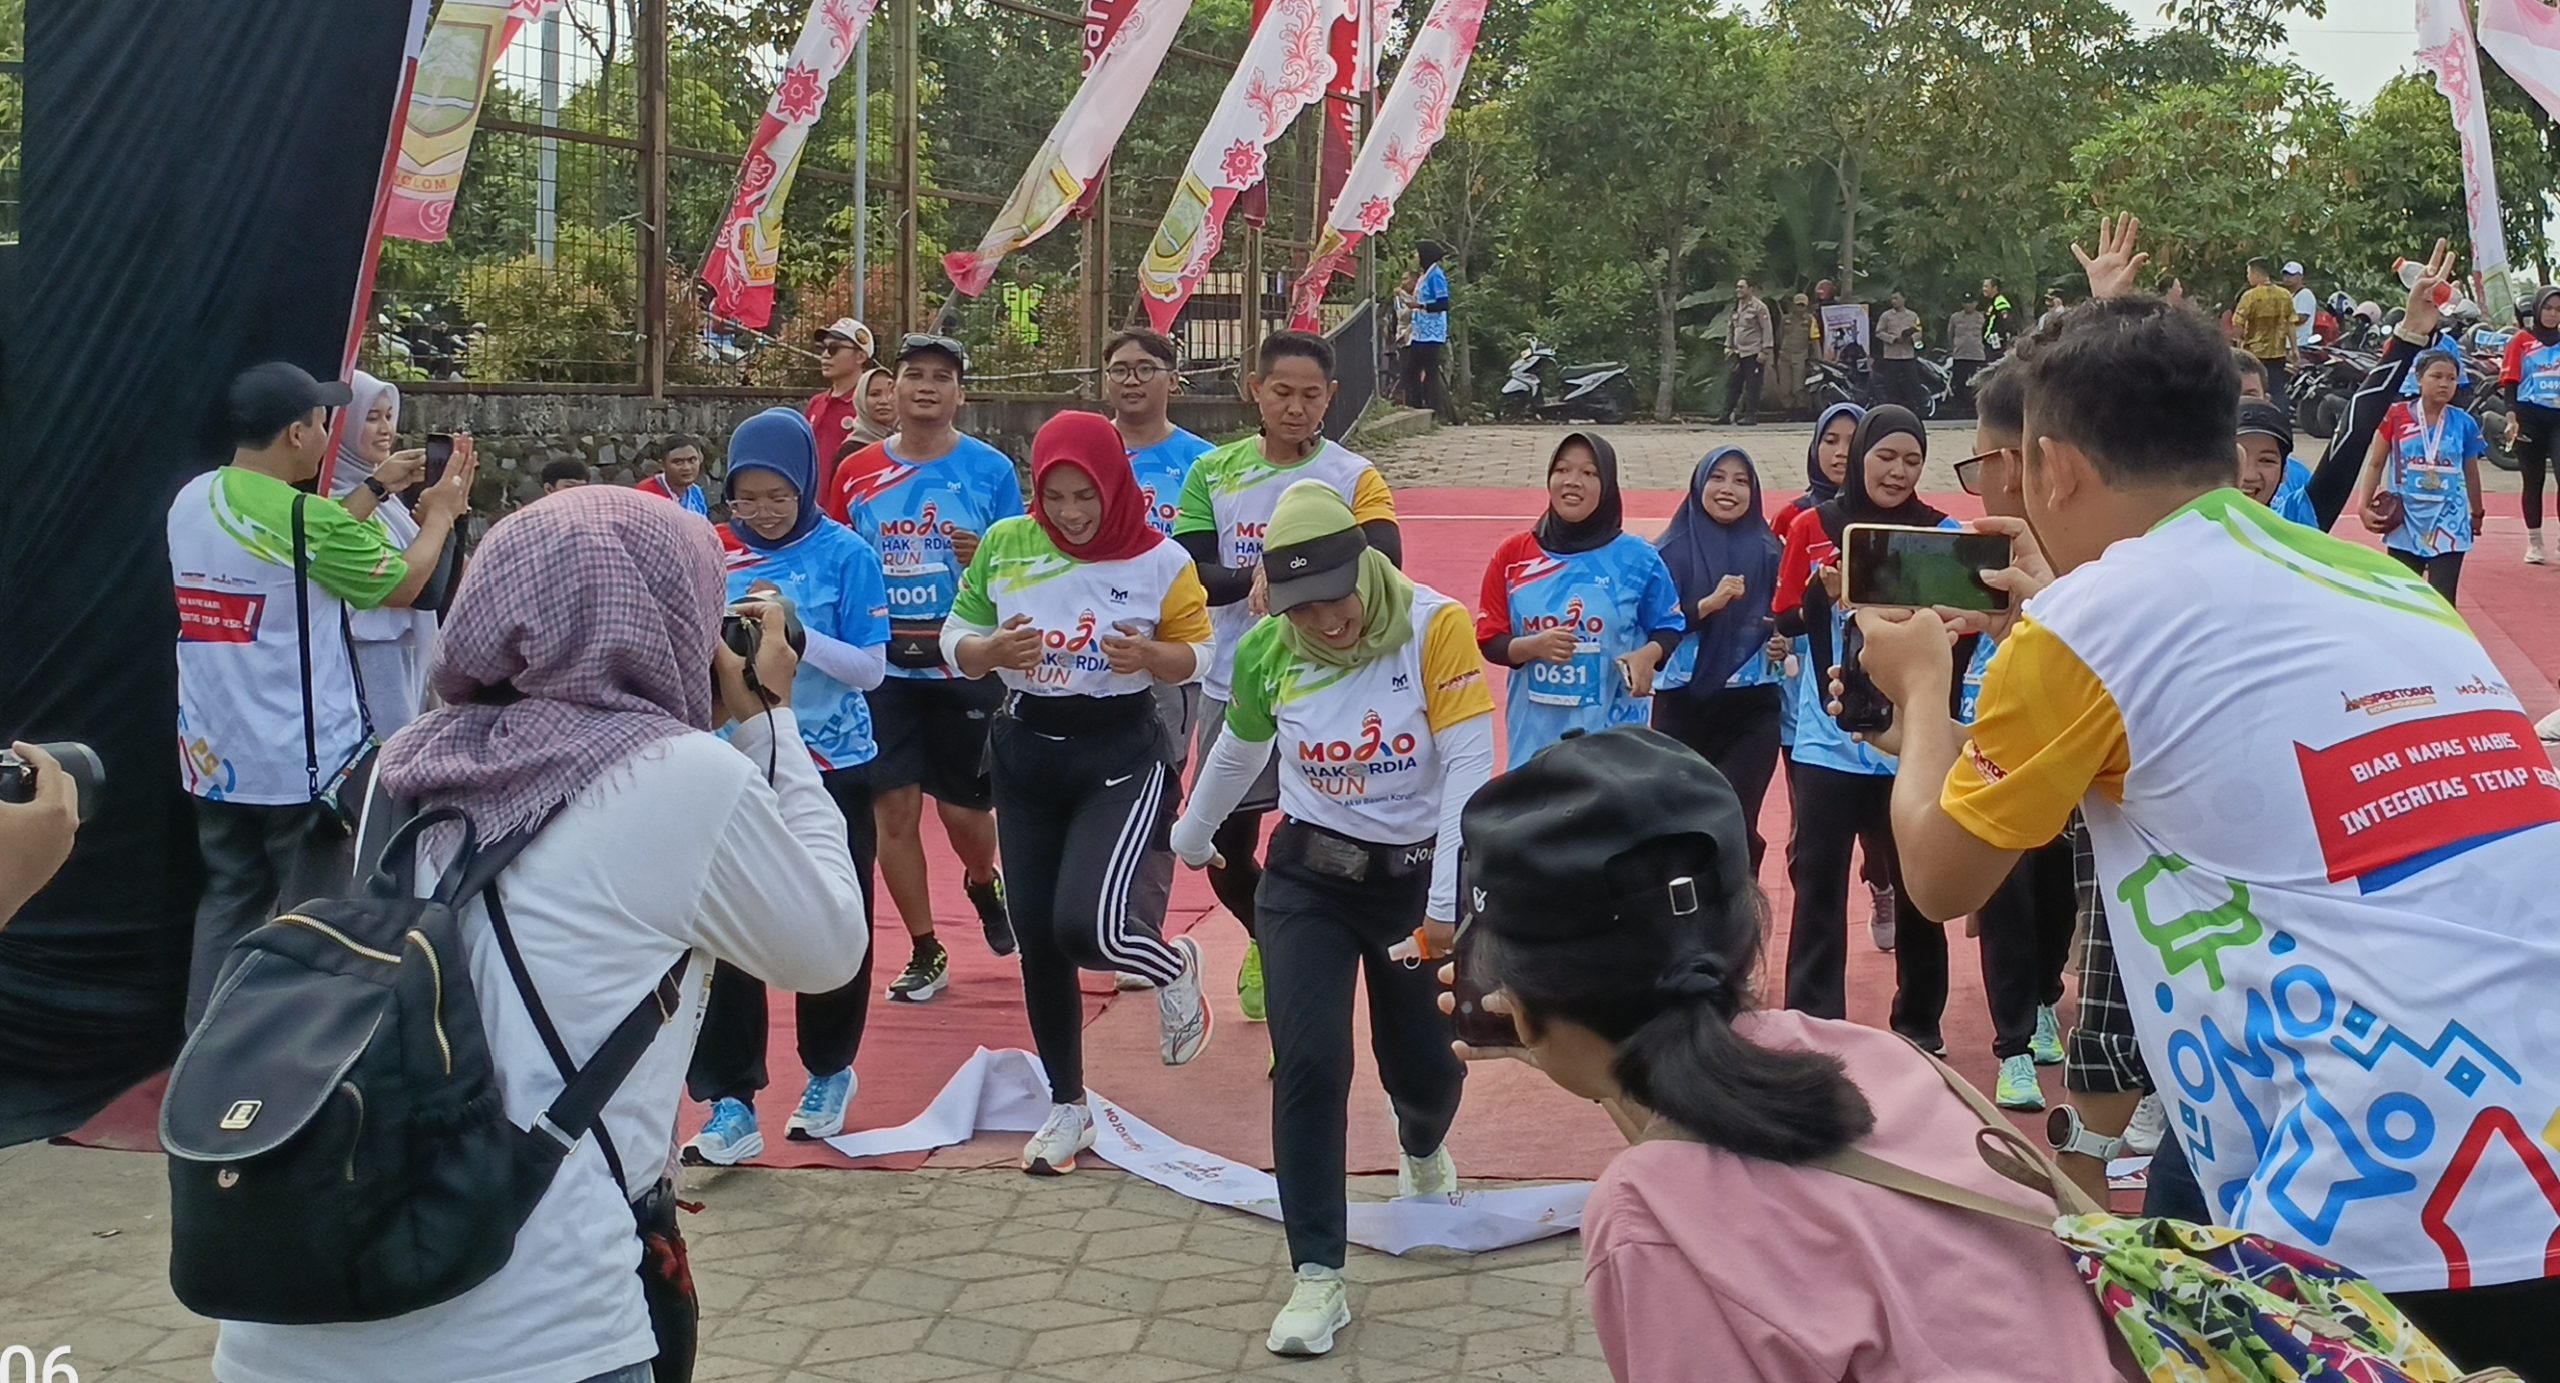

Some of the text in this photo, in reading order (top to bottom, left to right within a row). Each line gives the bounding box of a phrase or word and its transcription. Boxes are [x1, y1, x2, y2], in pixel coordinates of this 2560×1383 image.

[884, 552, 922, 566] RUN
[887, 584, 938, 606] 1001
[1025, 666, 1072, 685] RUN
[1534, 662, 1588, 685] 0631
[2350, 732, 2522, 783] BIAR NAPAS HABIS,
[1310, 776, 1366, 796] RUN
[2339, 776, 2469, 836] INTEGRITAS
[2470, 767, 2530, 793] TETAP
